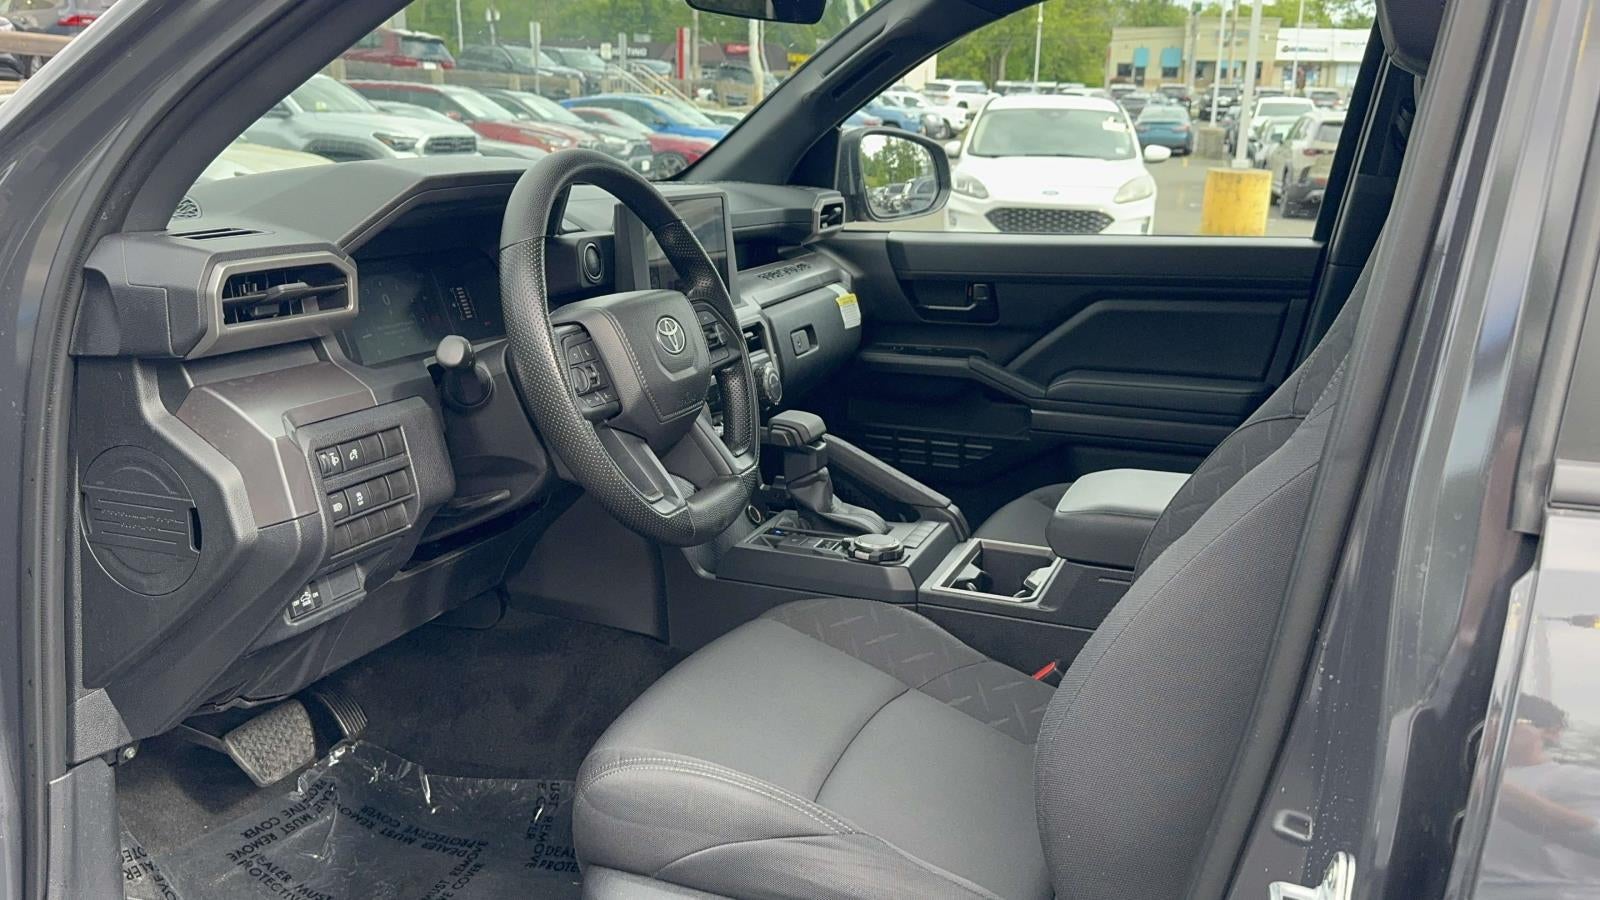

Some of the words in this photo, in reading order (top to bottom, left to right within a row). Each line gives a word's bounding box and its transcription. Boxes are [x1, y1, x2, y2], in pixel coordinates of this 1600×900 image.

[549, 782, 560, 808] UST
[240, 816, 281, 839] COVER
[281, 811, 312, 835] MUST
[226, 832, 278, 861] REMOVE
[421, 842, 468, 858] DEALER
[452, 862, 486, 890] COVER
